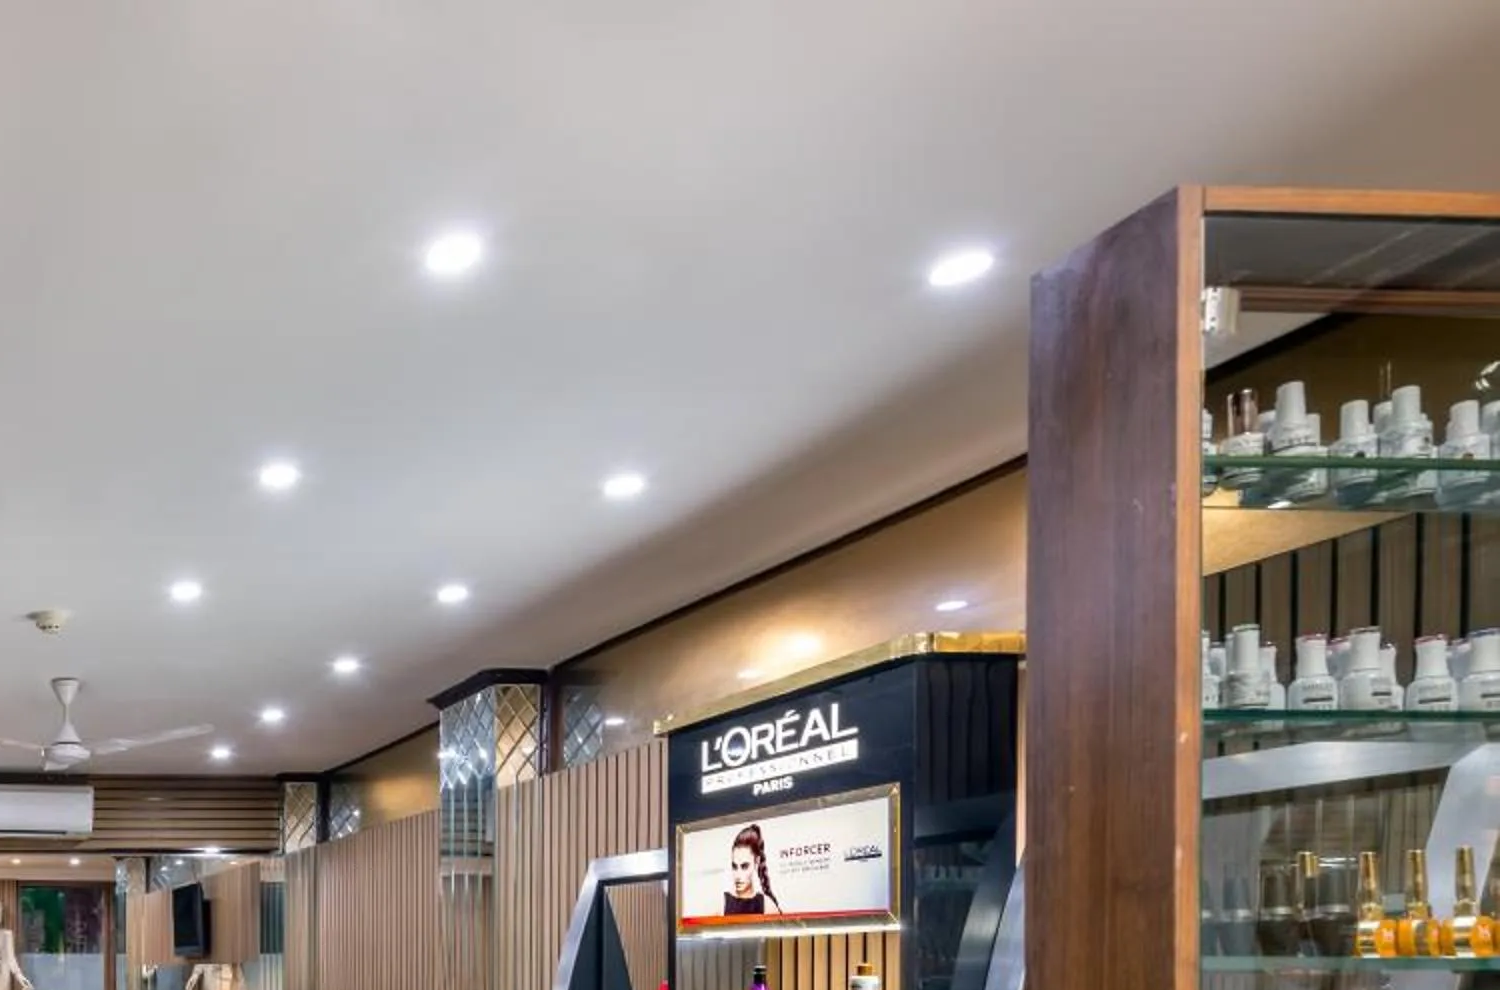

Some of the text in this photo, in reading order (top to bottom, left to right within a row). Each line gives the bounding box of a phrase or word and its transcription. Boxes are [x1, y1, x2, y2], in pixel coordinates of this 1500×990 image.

[701, 702, 859, 773] L'ORÉAL
[752, 776, 794, 797] PARIS
[779, 843, 831, 857] INFORCER
